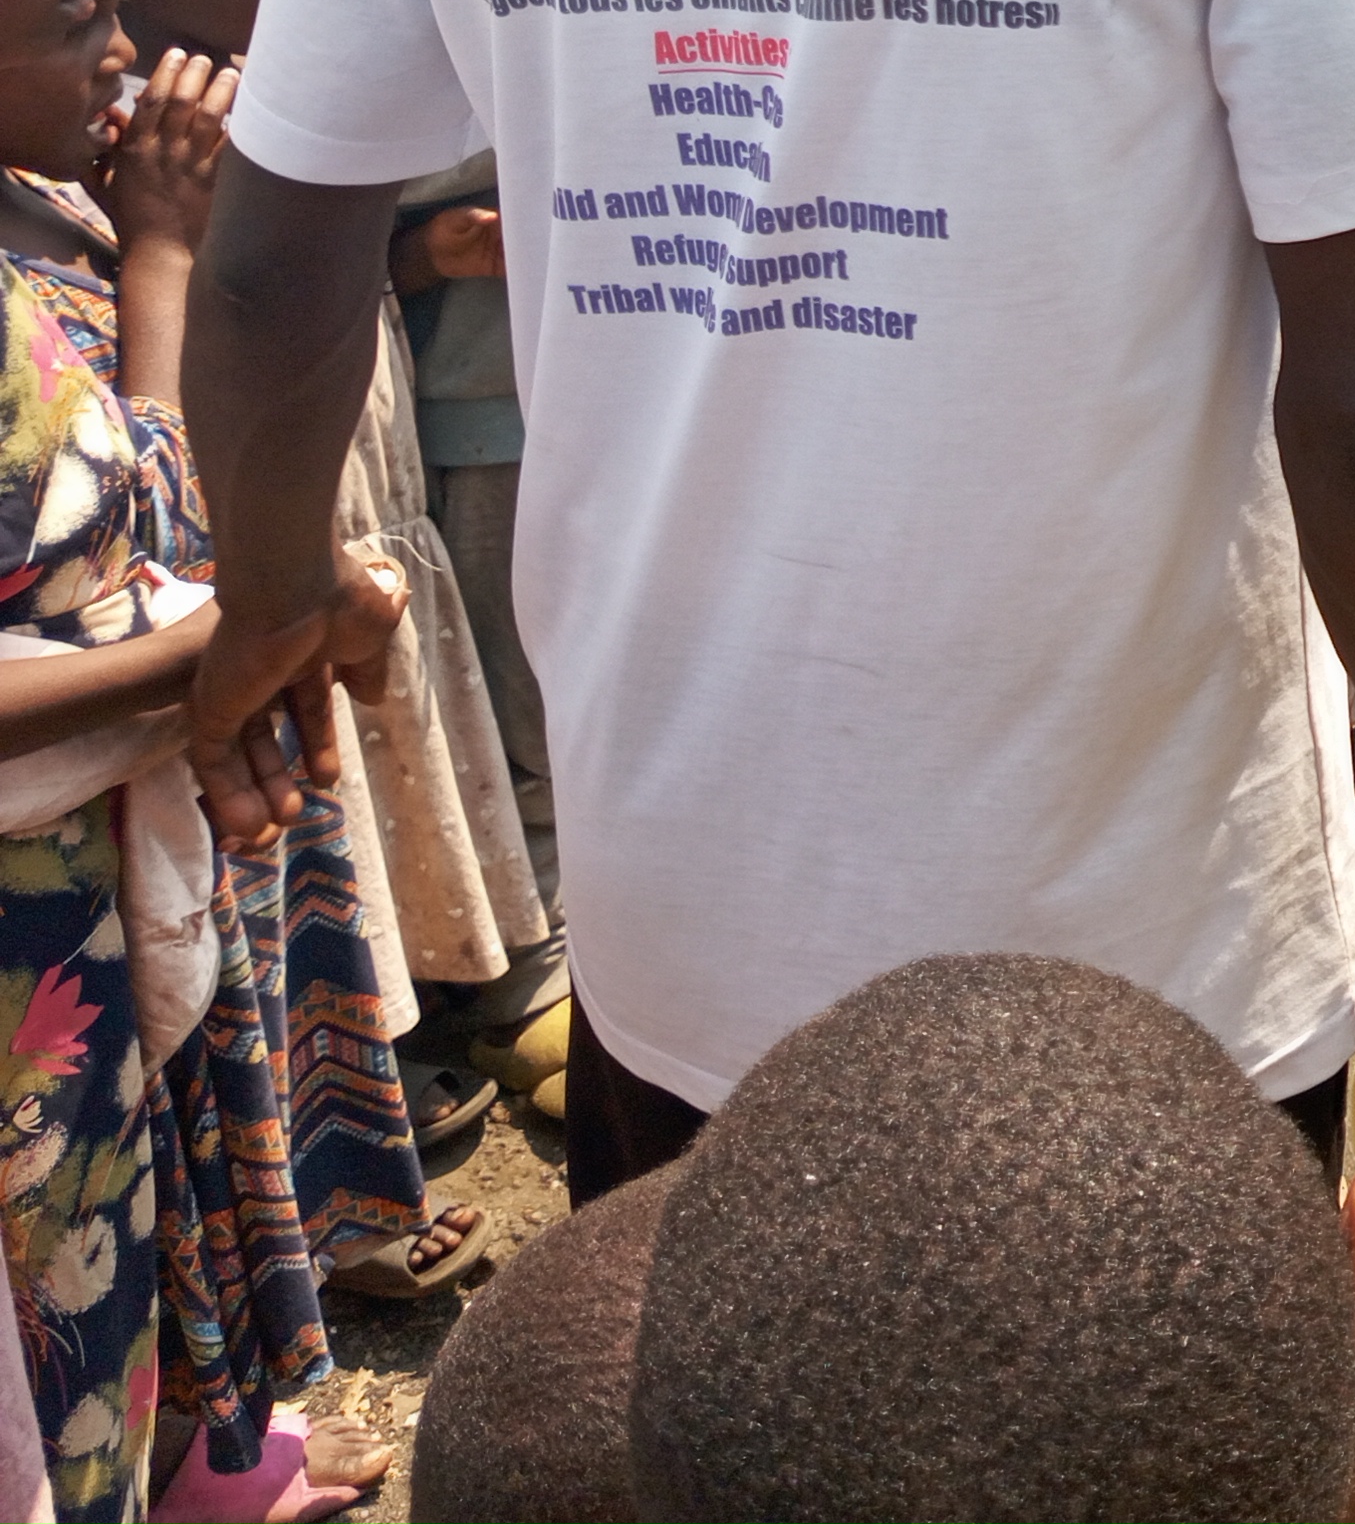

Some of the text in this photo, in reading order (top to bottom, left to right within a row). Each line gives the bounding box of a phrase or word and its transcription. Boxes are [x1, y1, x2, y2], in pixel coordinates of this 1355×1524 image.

[654, 29, 789, 68] Activities
[604, 185, 670, 219] and
[725, 249, 850, 287] support
[568, 282, 666, 314] Tribal
[721, 299, 785, 336] and
[792, 297, 917, 340] disaster
